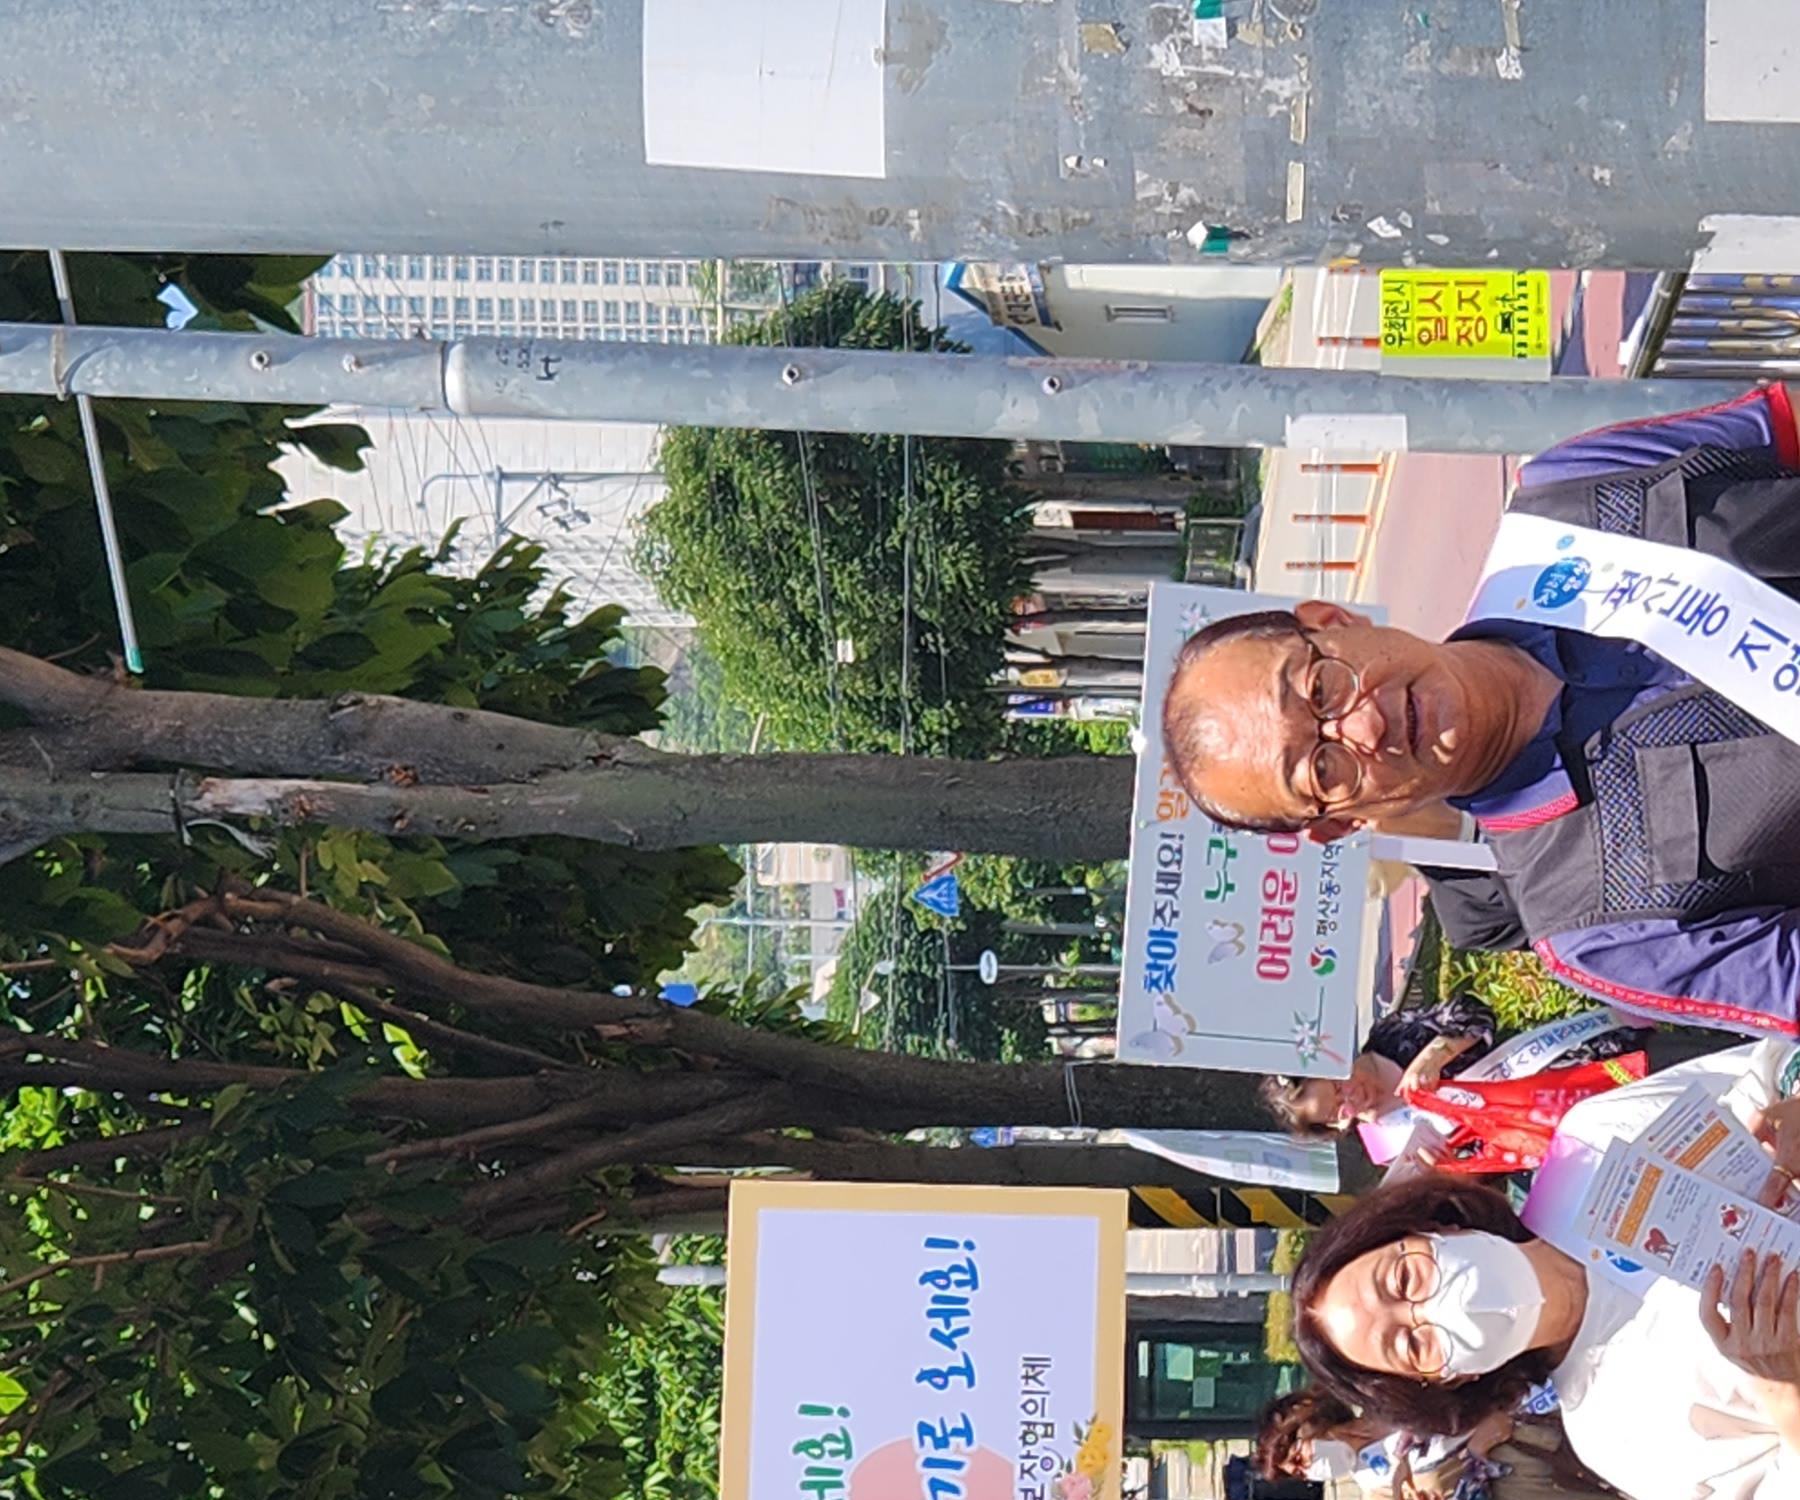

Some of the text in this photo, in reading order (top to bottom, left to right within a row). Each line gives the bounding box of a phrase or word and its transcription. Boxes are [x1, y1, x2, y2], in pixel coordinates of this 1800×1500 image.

[1383, 280, 1411, 348] 우회전 시
[1415, 281, 1449, 346] 일시
[1454, 281, 1488, 347] 정지
[1601, 570, 1731, 637] 평산동
[1203, 828, 1237, 903] 누구
[1143, 832, 1185, 994] 찾아주세요!
[1255, 868, 1298, 981] 어려운
[915, 1236, 978, 1391] 오세요!
